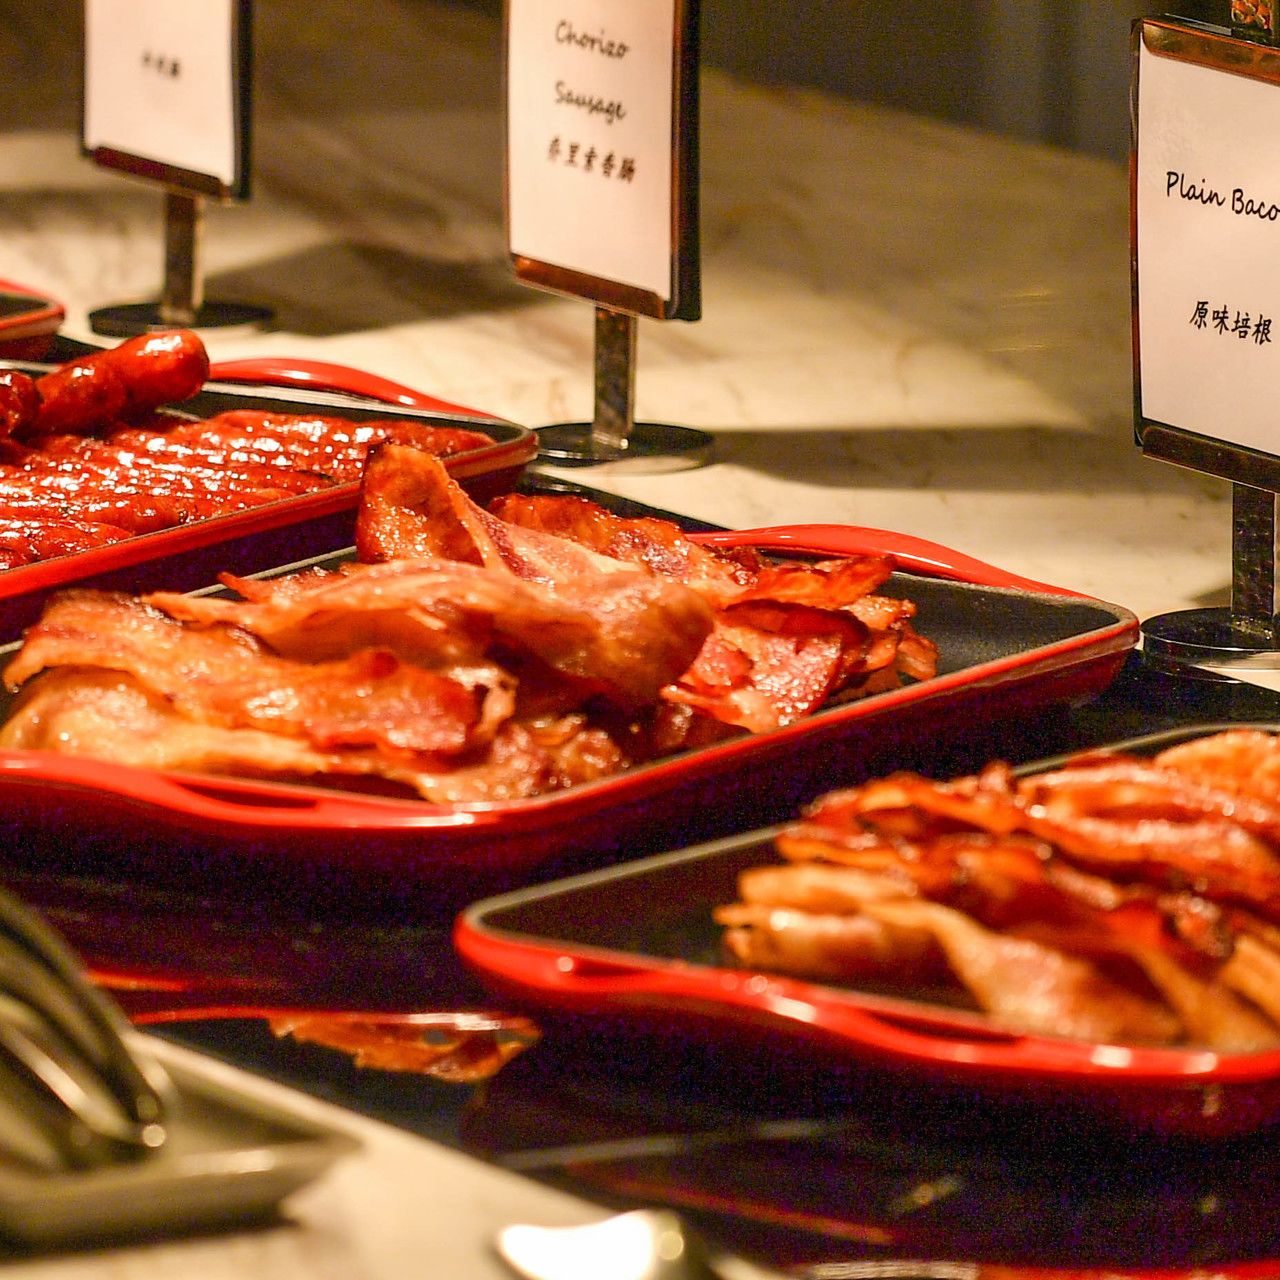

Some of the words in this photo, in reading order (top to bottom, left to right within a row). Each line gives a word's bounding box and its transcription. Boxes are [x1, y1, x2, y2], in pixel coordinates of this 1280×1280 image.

[555, 20, 630, 58] Chorizo
[555, 80, 627, 125] Sausage
[1166, 171, 1227, 207] Plain
[1190, 300, 1273, 346] 原味培根
